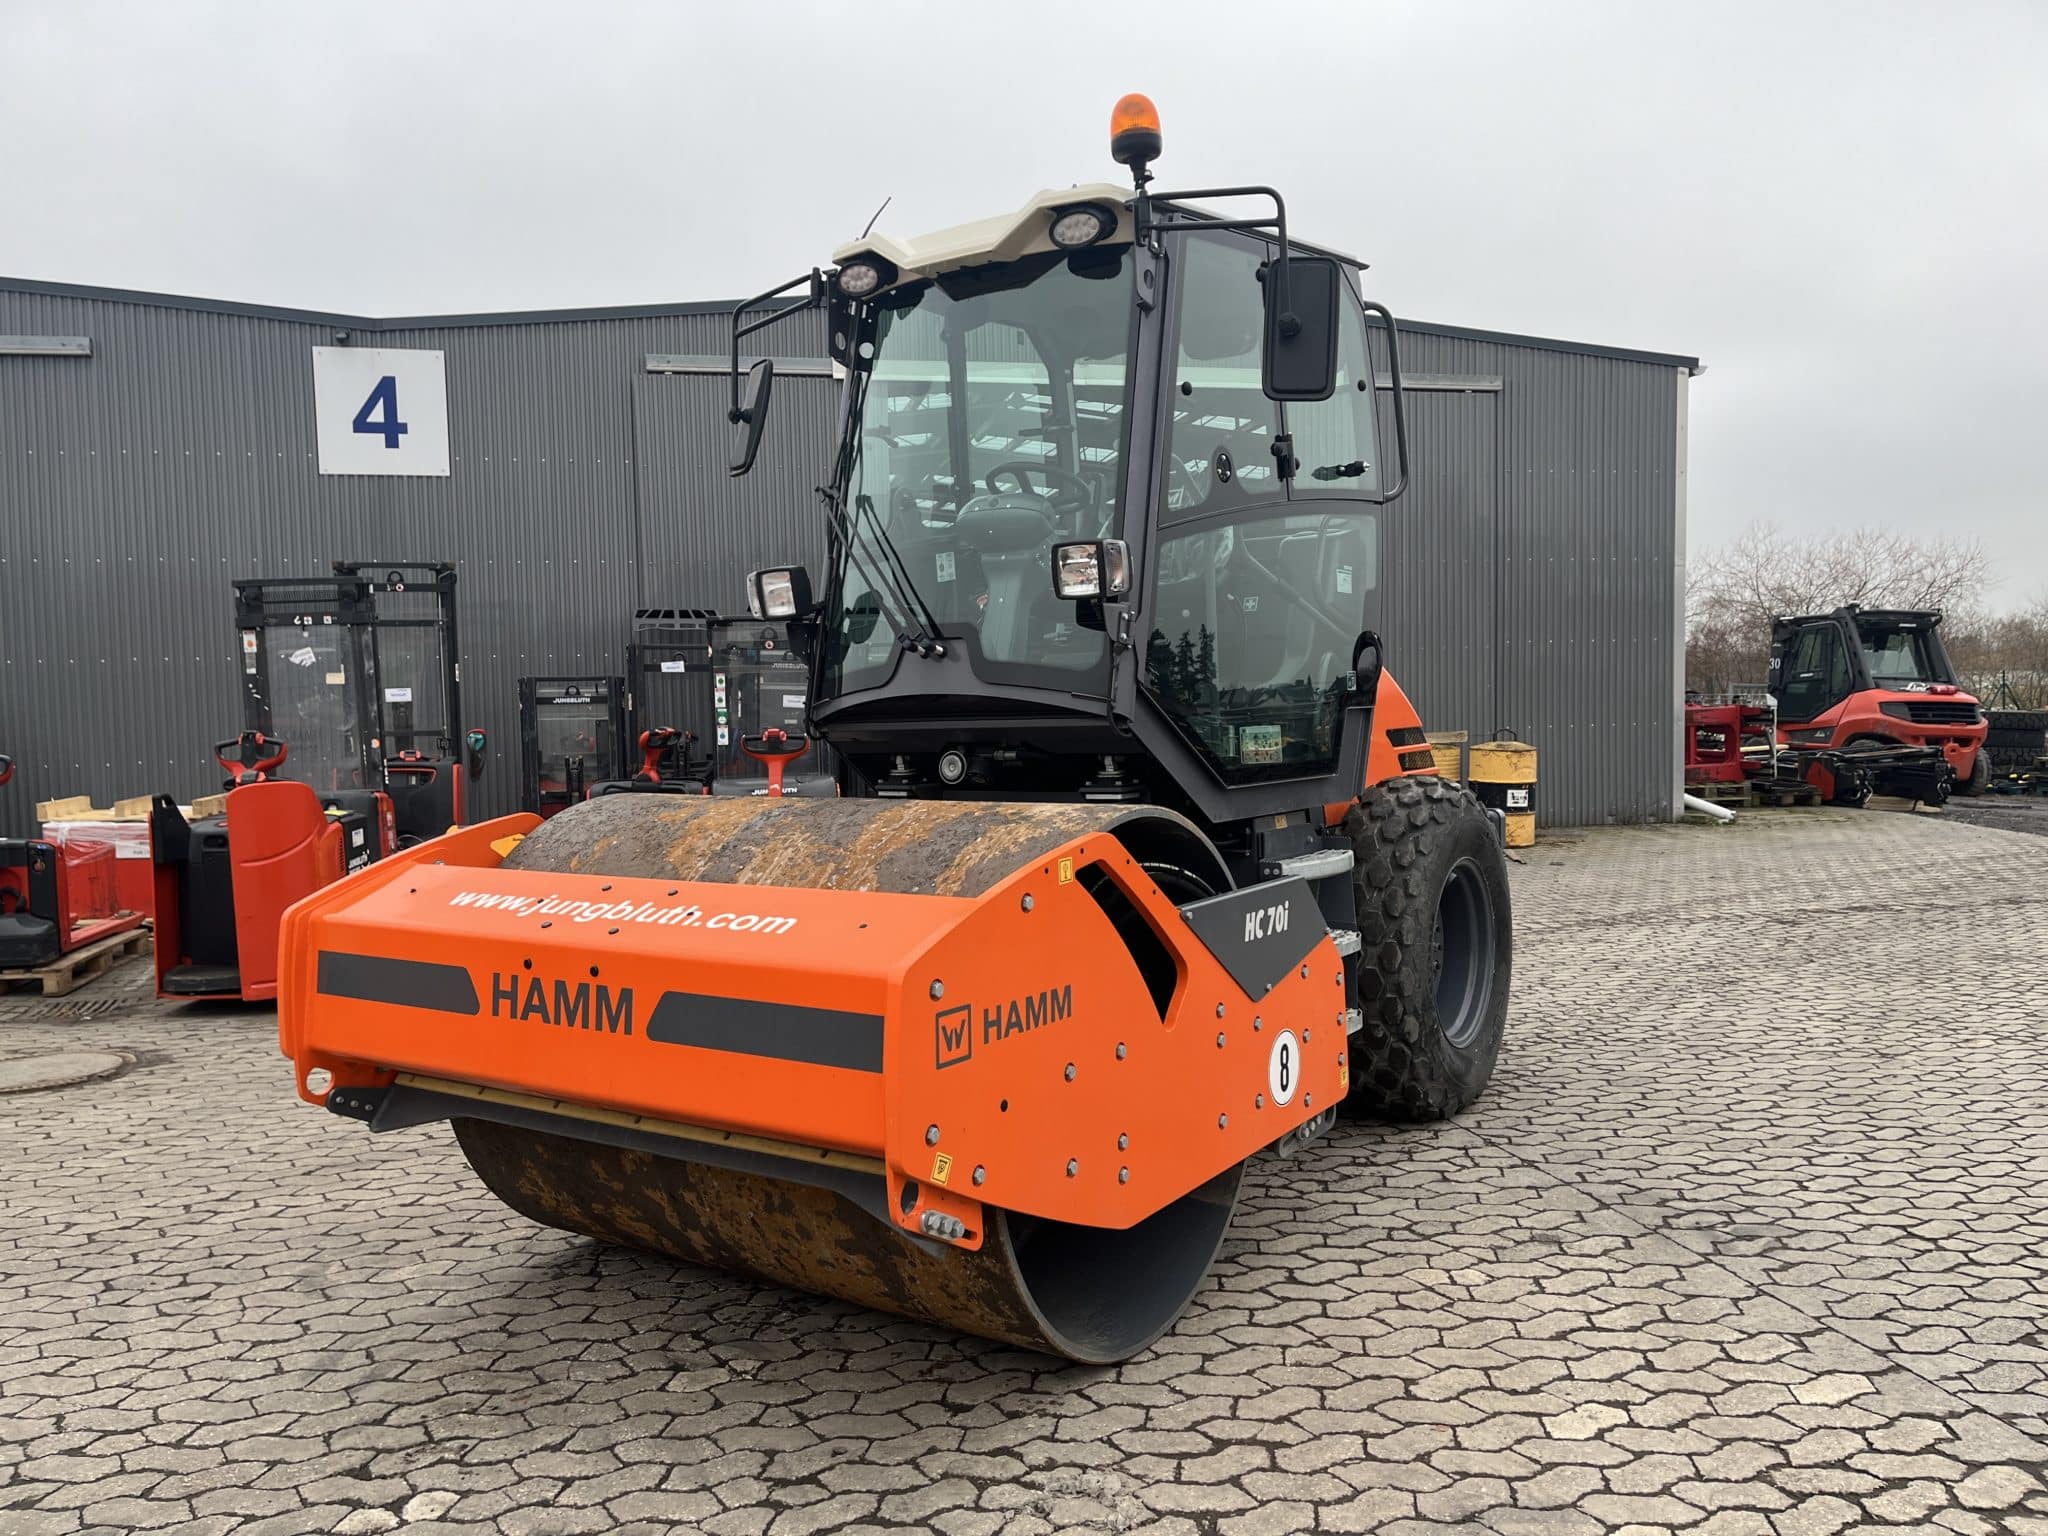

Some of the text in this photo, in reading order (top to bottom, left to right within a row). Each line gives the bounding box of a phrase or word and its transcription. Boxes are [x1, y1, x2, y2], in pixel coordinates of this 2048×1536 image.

[353, 376, 408, 448] 4
[552, 696, 591, 704] JUNGBLUTH
[448, 890, 798, 935] www.jungbluth.com
[1244, 901, 1290, 942] HC 70i
[491, 972, 634, 1036] HAMM
[983, 985, 1073, 1045] HAMM
[1280, 1043, 1290, 1092] 8
